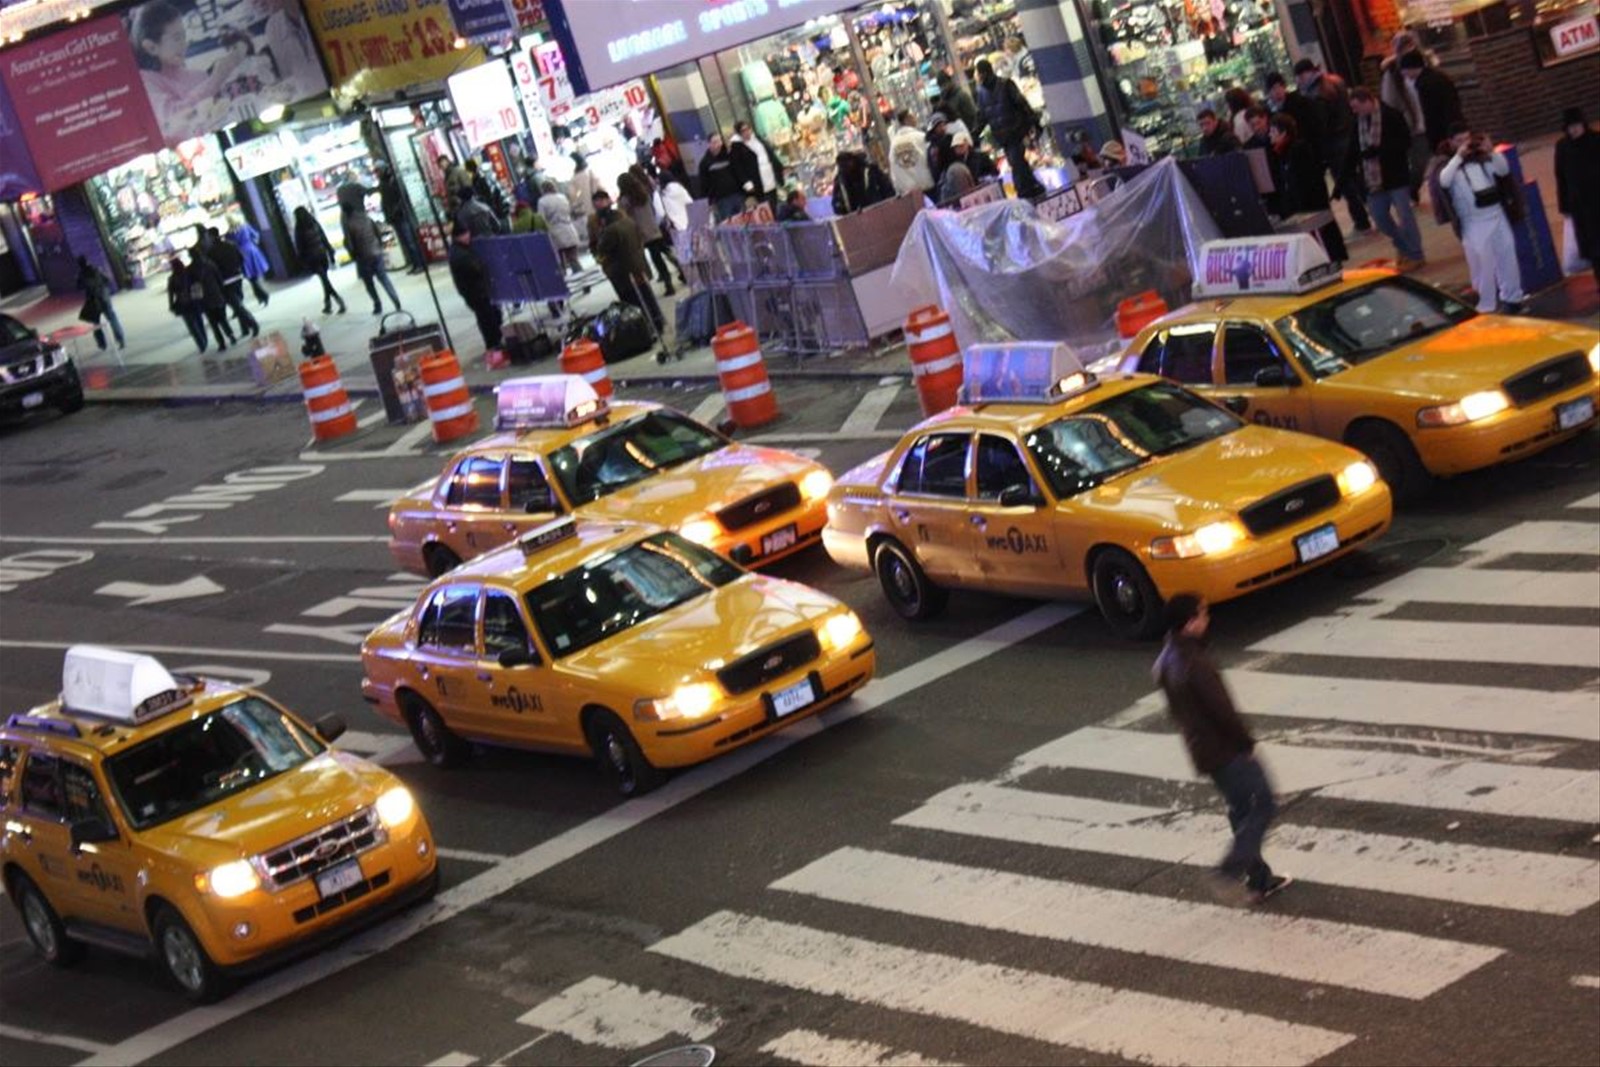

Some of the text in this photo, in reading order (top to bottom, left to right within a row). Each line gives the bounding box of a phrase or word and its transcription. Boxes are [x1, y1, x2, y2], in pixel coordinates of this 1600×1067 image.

[1560, 22, 1596, 49] ATM
[585, 106, 600, 126] 3
[1206, 251, 1237, 285] BILLY
